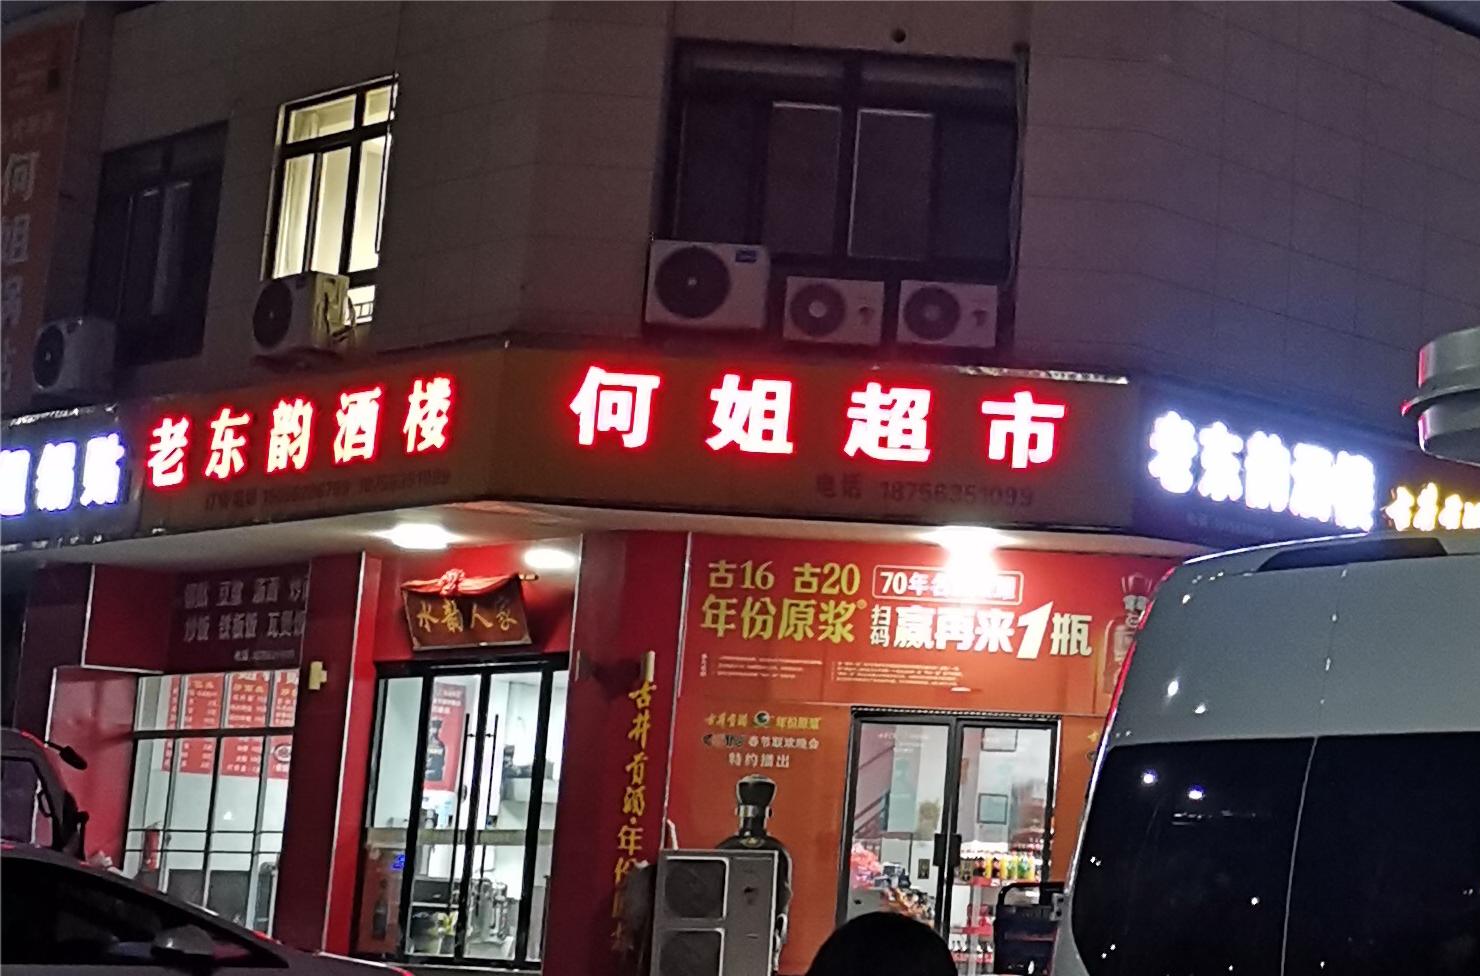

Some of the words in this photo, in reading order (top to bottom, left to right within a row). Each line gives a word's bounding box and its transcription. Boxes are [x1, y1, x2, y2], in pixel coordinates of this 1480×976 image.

[147, 377, 453, 488] 老东韵酒楼
[569, 366, 1066, 469] 何姐超市
[708, 560, 775, 591] 古16
[793, 562, 861, 596] 古20
[701, 594, 857, 644] 年份原浆
[728, 752, 790, 768] 特约播出
